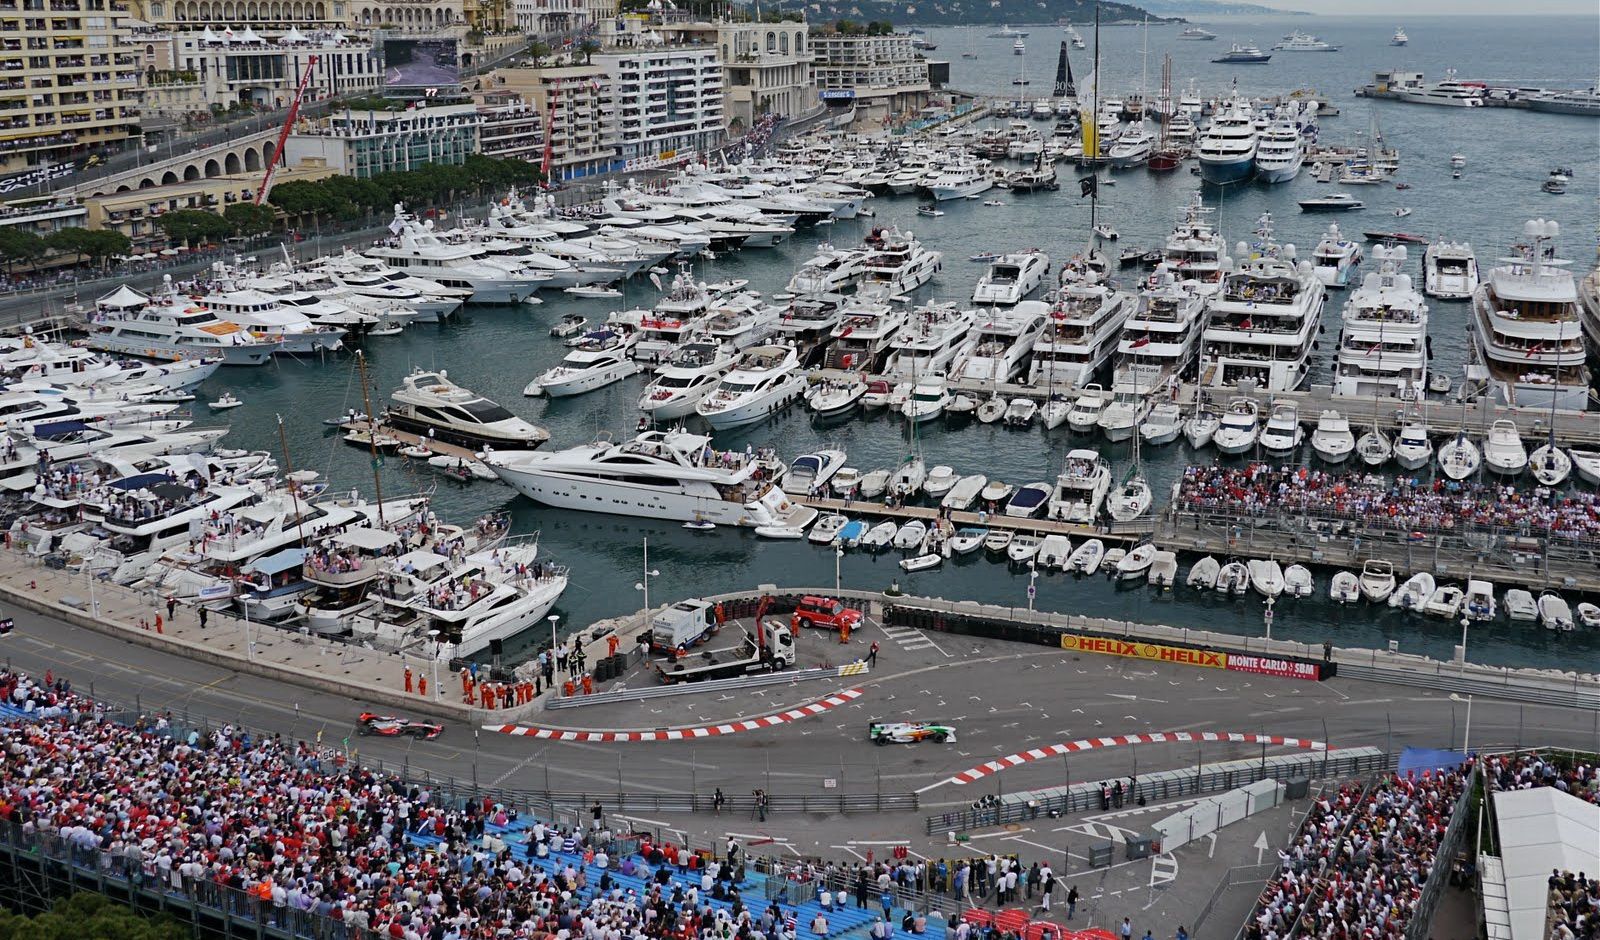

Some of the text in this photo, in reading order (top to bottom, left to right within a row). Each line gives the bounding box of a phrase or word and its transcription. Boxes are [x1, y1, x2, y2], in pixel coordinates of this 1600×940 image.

[425, 88, 437, 97] 77
[1079, 638, 1223, 667] HELIX HELIX
[1228, 655, 1314, 675] MONTE CARLO SBM
